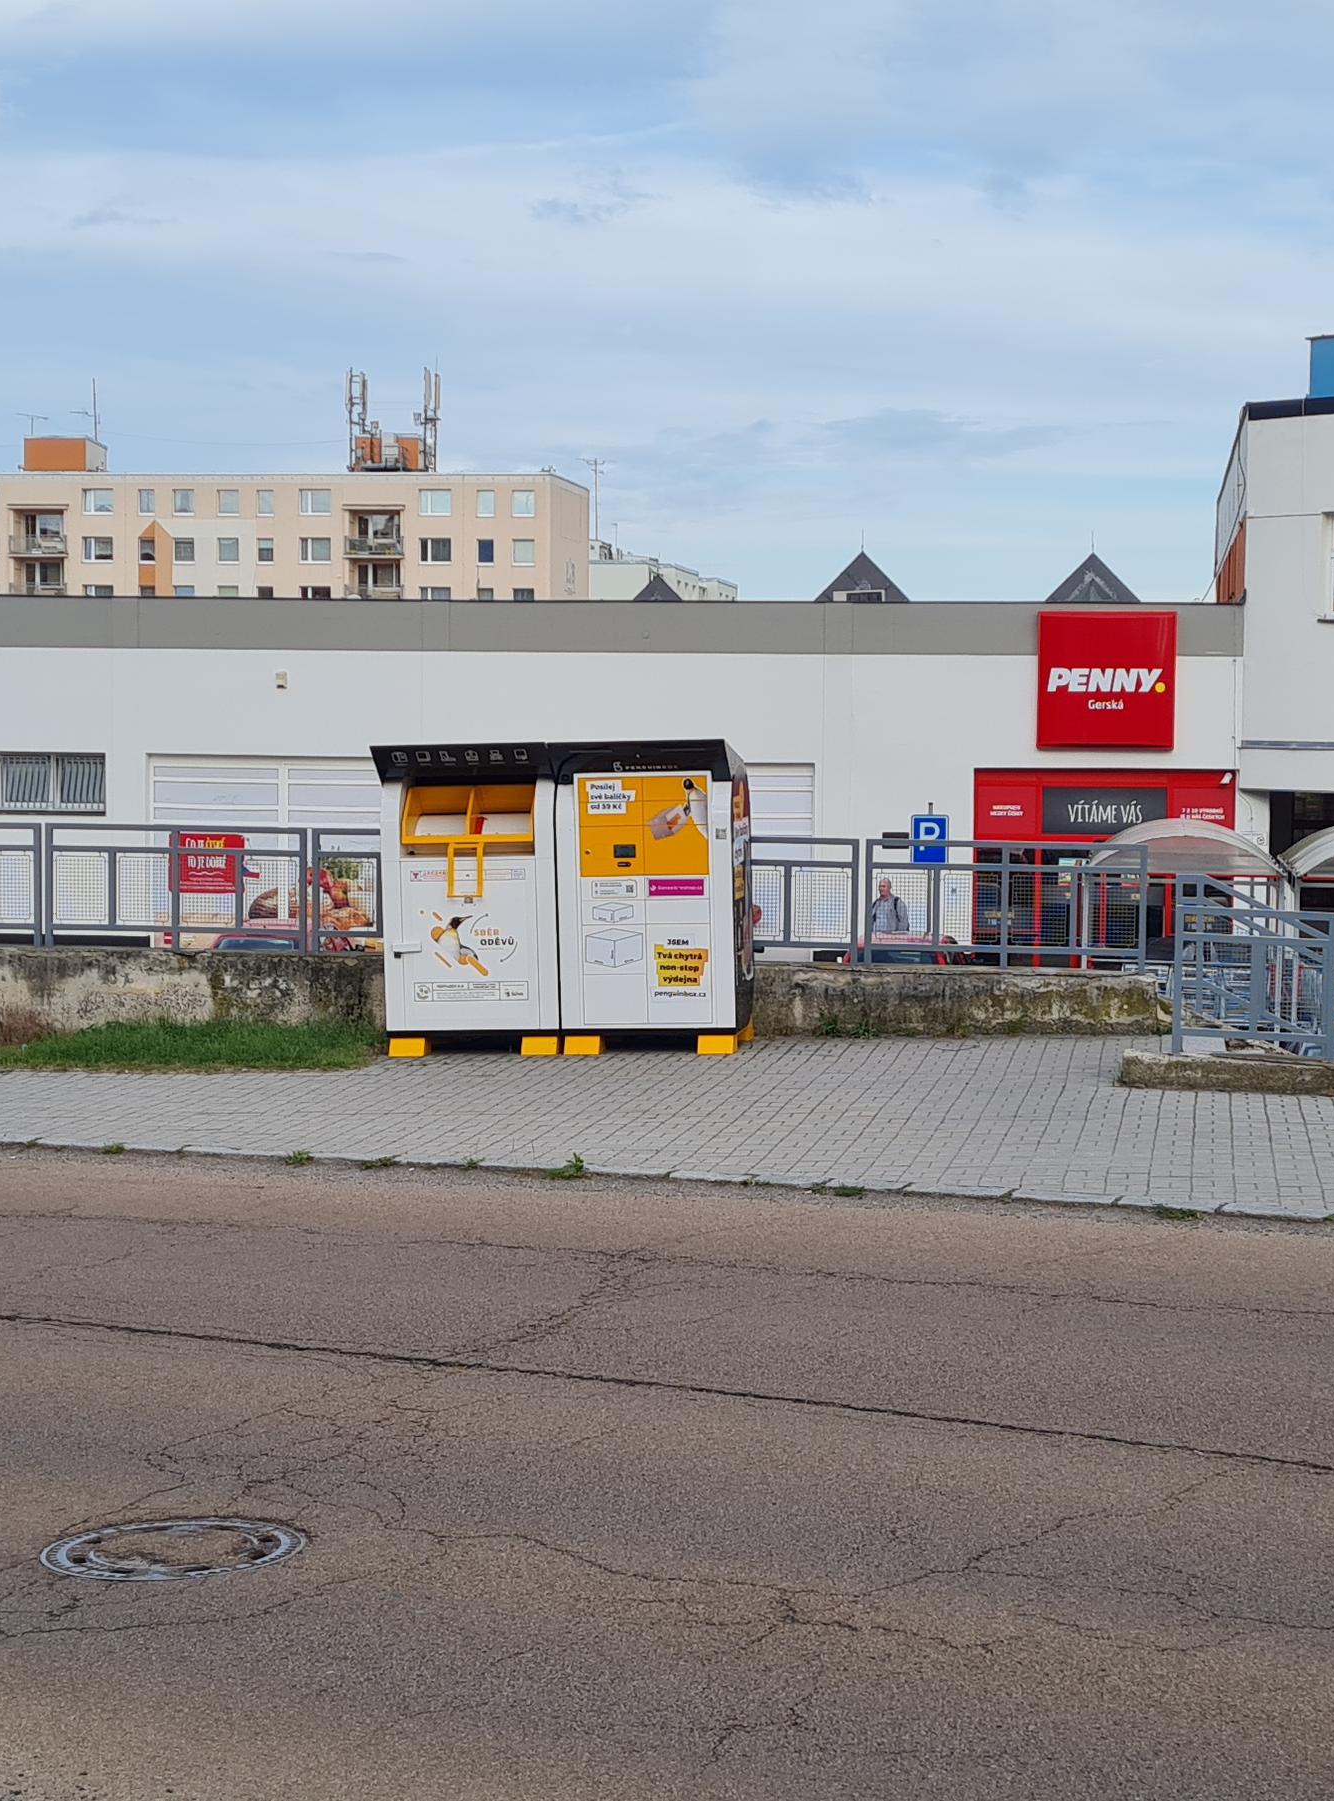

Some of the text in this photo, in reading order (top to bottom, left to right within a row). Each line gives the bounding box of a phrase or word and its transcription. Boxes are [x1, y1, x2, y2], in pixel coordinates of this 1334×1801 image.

[1088, 699, 1124, 709] Gerská
[1068, 800, 1142, 823] VÍTÁME VÁS
[919, 822, 940, 851] P
[480, 936, 514, 946] ODĚVŮ
[657, 951, 703, 961] Tvá chytrá
[660, 964, 699, 973] non-stop
[663, 974, 698, 984] výdejna
